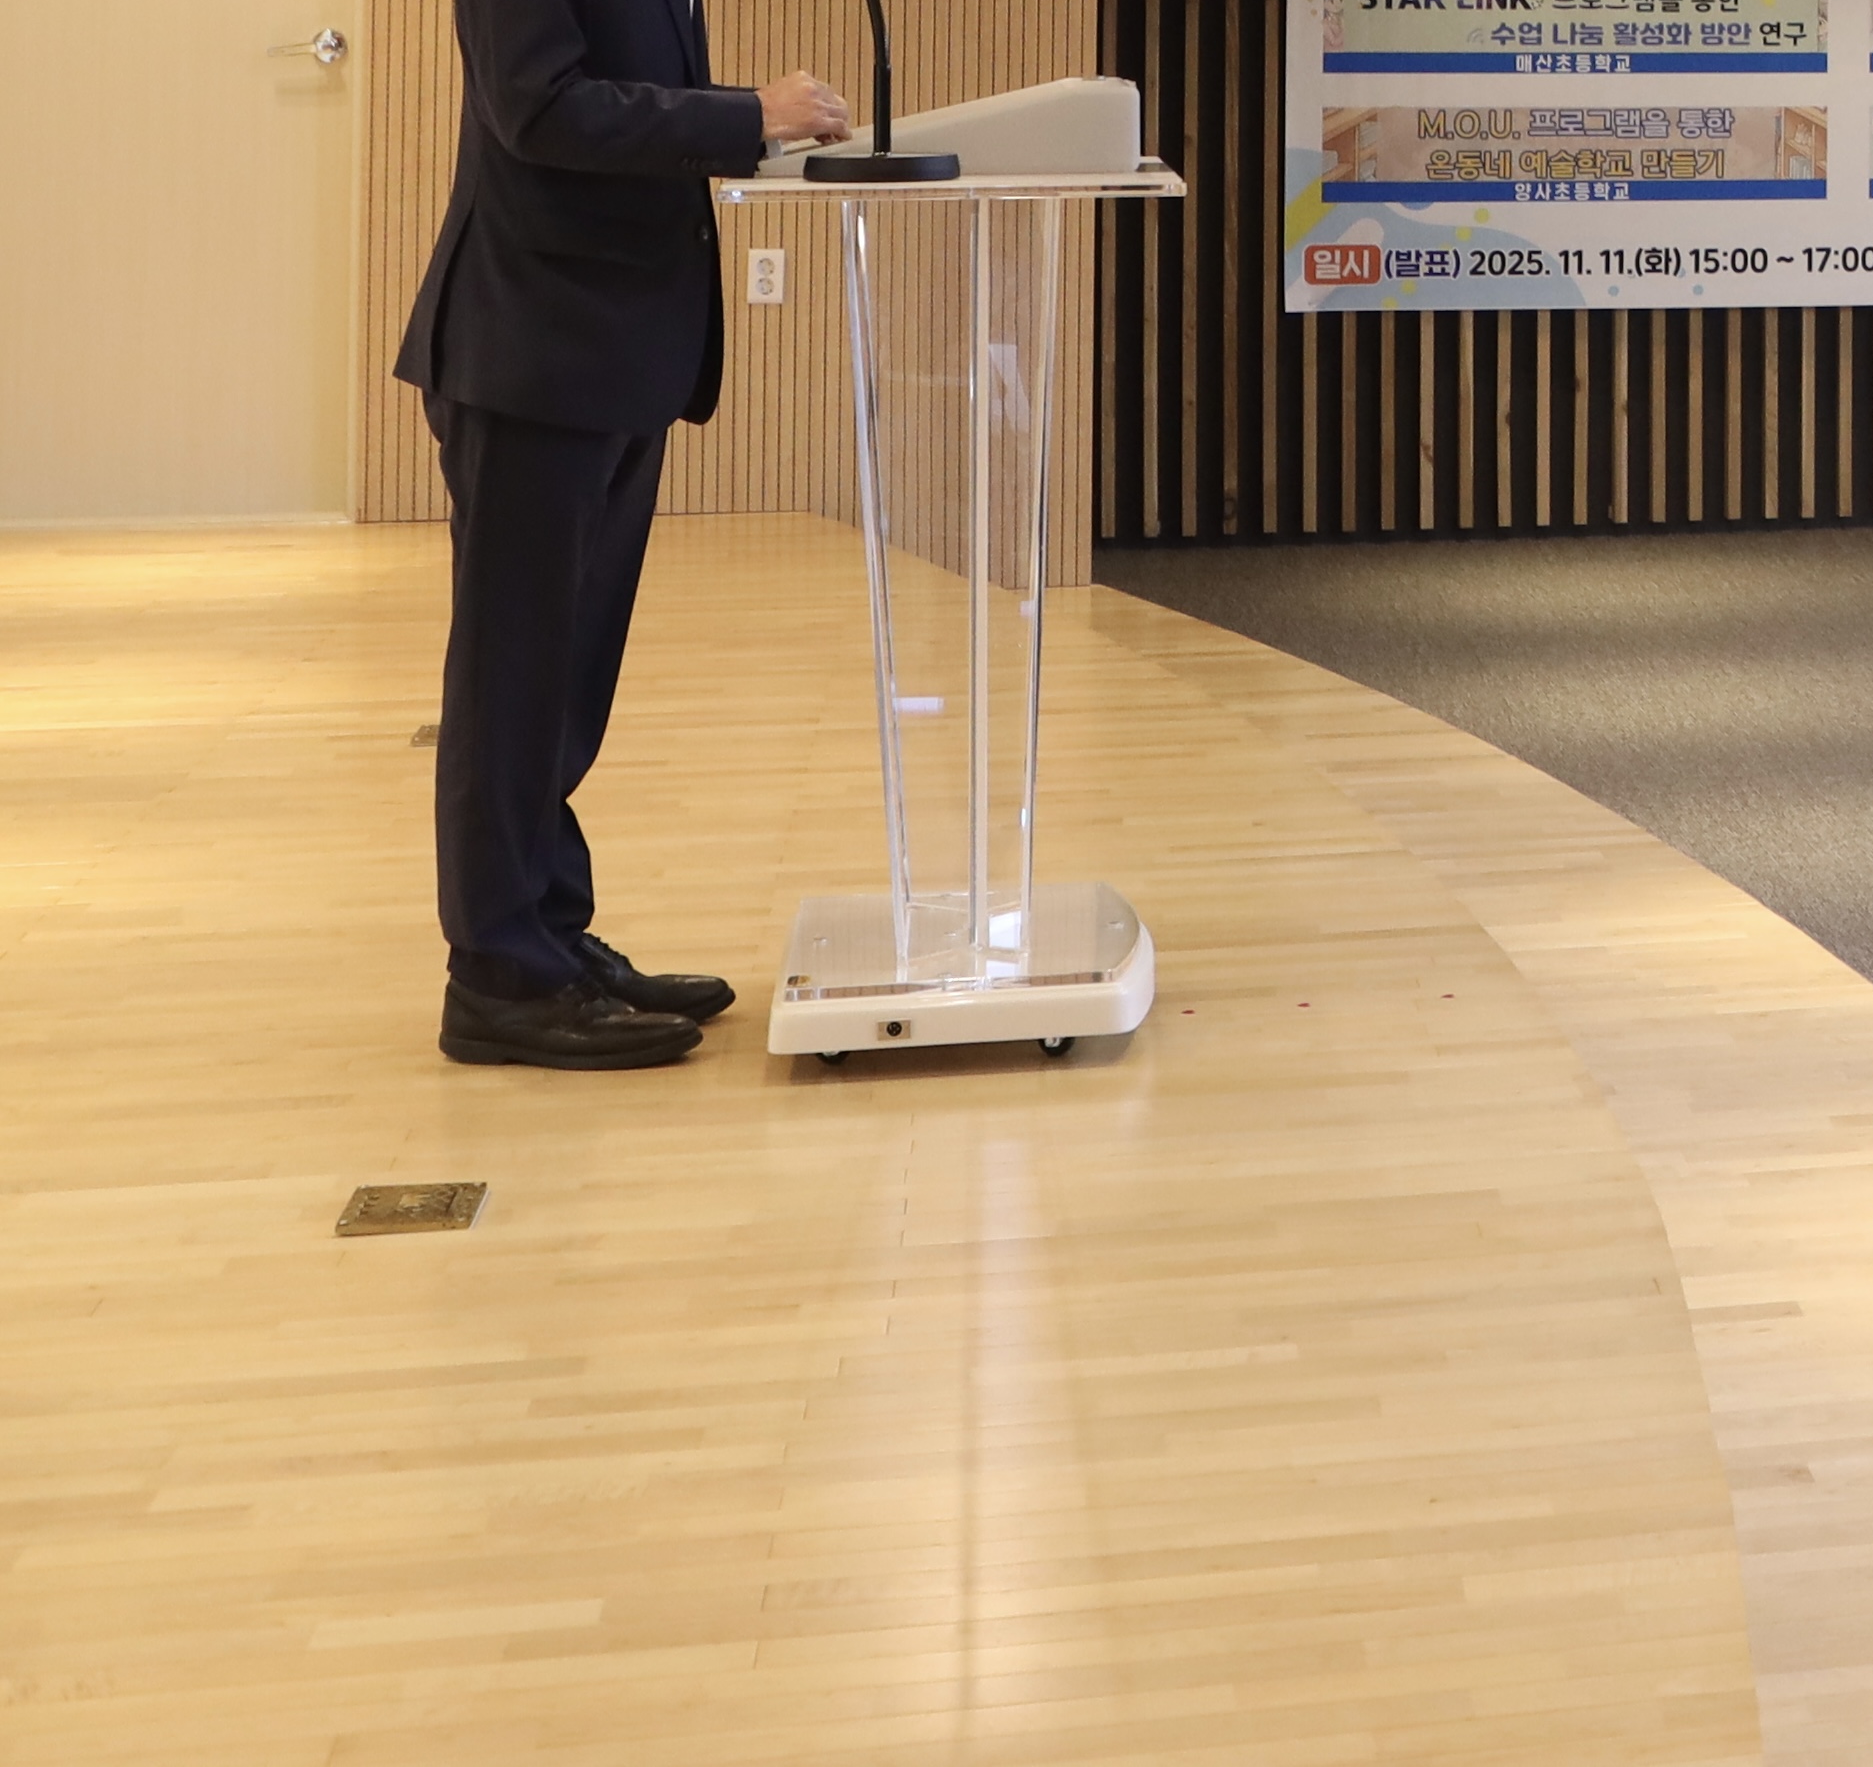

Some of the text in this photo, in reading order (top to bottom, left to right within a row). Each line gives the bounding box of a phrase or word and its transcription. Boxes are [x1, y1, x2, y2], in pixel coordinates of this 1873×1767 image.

[1491, 21, 1806, 47] 수업 나눔 활성화 방안 연구
[1516, 54, 1631, 73] 매산초등학교
[1418, 109, 1733, 139] M.O.U. 프로그램을 통한
[1425, 149, 1724, 180] 온동네 예술학교 만들기
[1514, 181, 1630, 200] 양사초등학교
[1312, 251, 1369, 279] 일시
[1384, 249, 1460, 280] (발표)
[1469, 250, 1550, 277] 2025.
[1558, 249, 1592, 275] 11.
[1602, 248, 1682, 279] 11.(화)
[1689, 247, 1768, 274] 15:00
